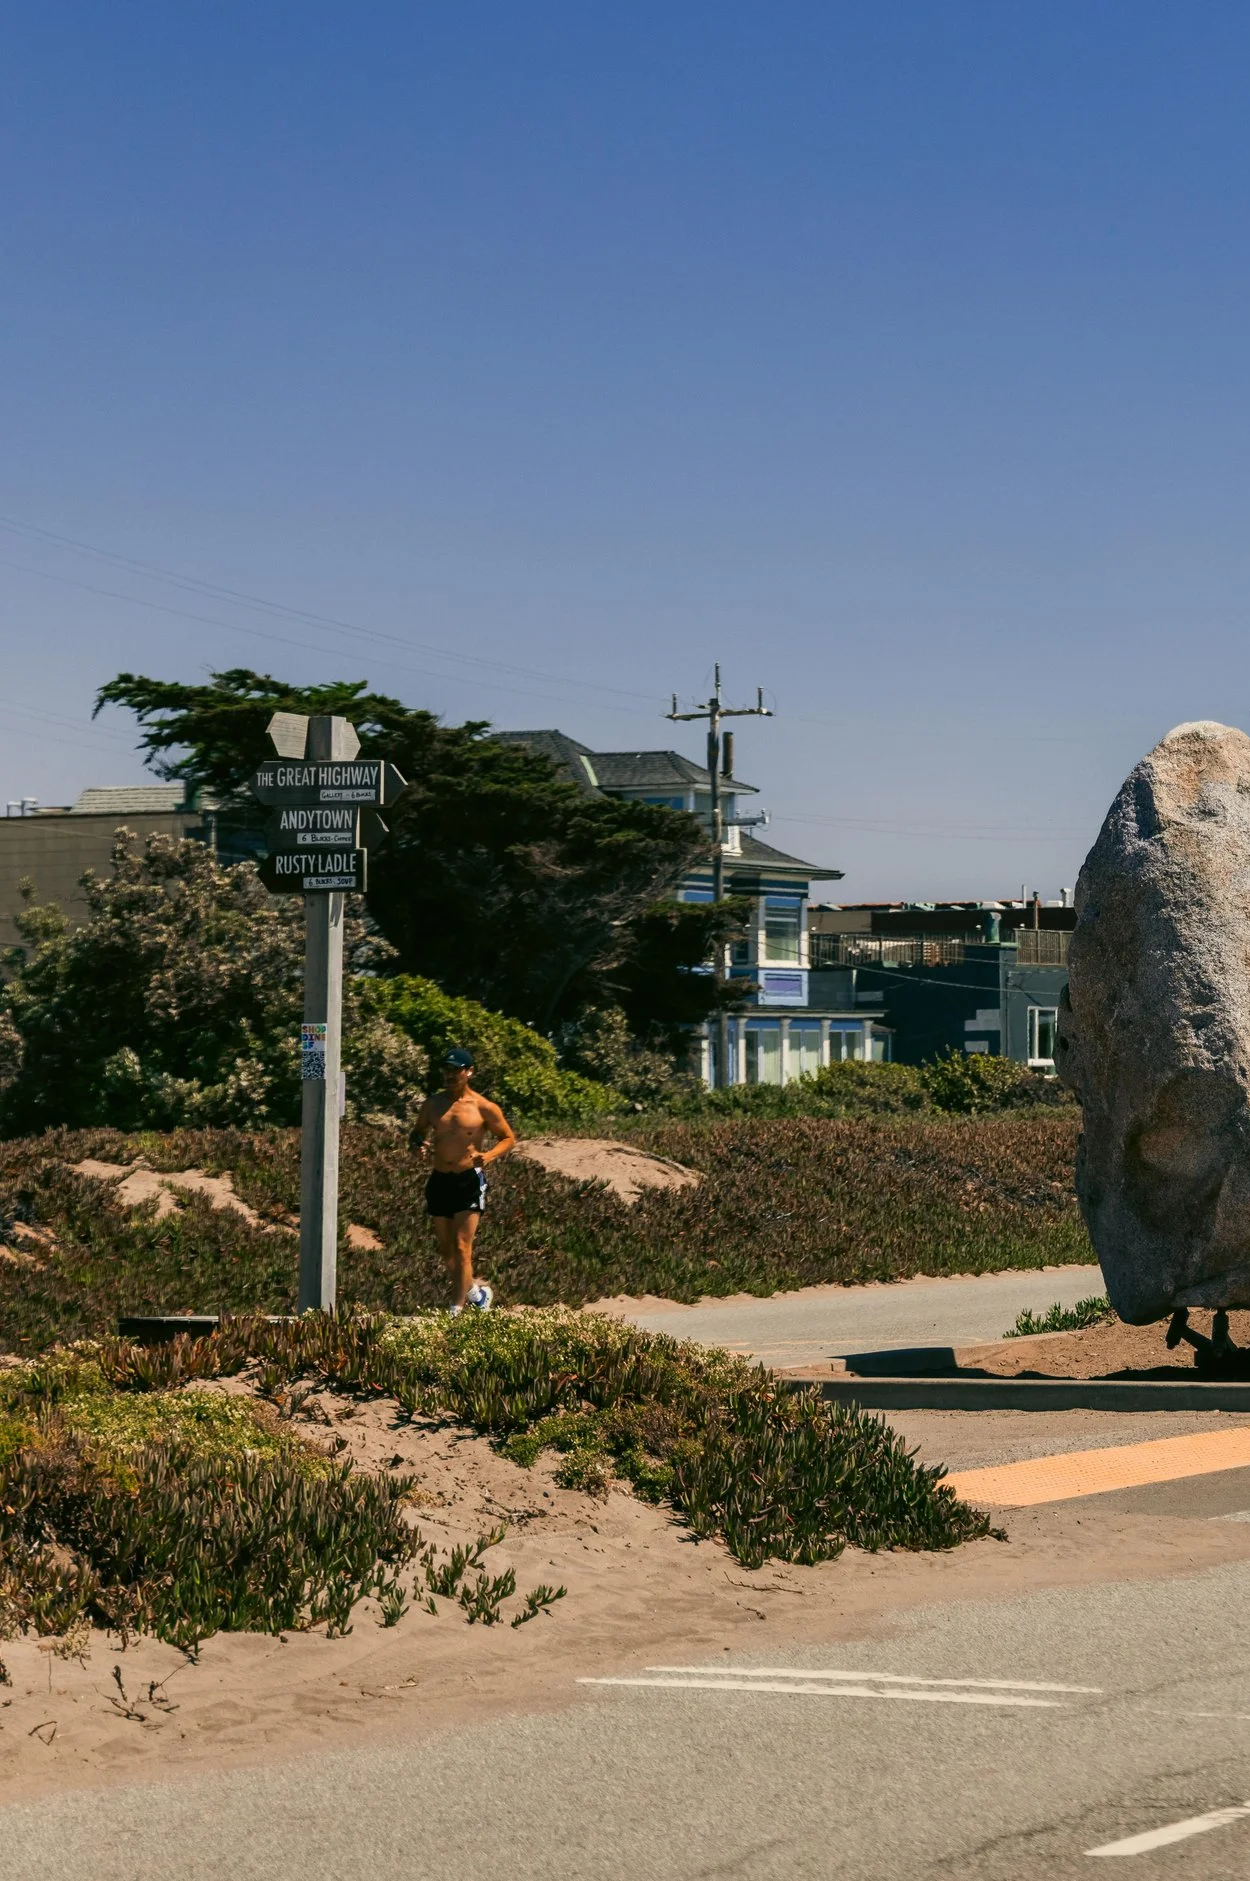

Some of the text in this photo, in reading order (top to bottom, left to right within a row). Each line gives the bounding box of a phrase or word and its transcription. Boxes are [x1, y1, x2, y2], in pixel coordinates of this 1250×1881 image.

[257, 766, 378, 787] THE GREAT HIGHWAY
[280, 810, 353, 830] ANDYTOWN
[302, 834, 307, 842] 6
[276, 853, 356, 874] RUSTY LADLE
[303, 1025, 326, 1033] SHOP
[303, 1041, 314, 1049] SF
